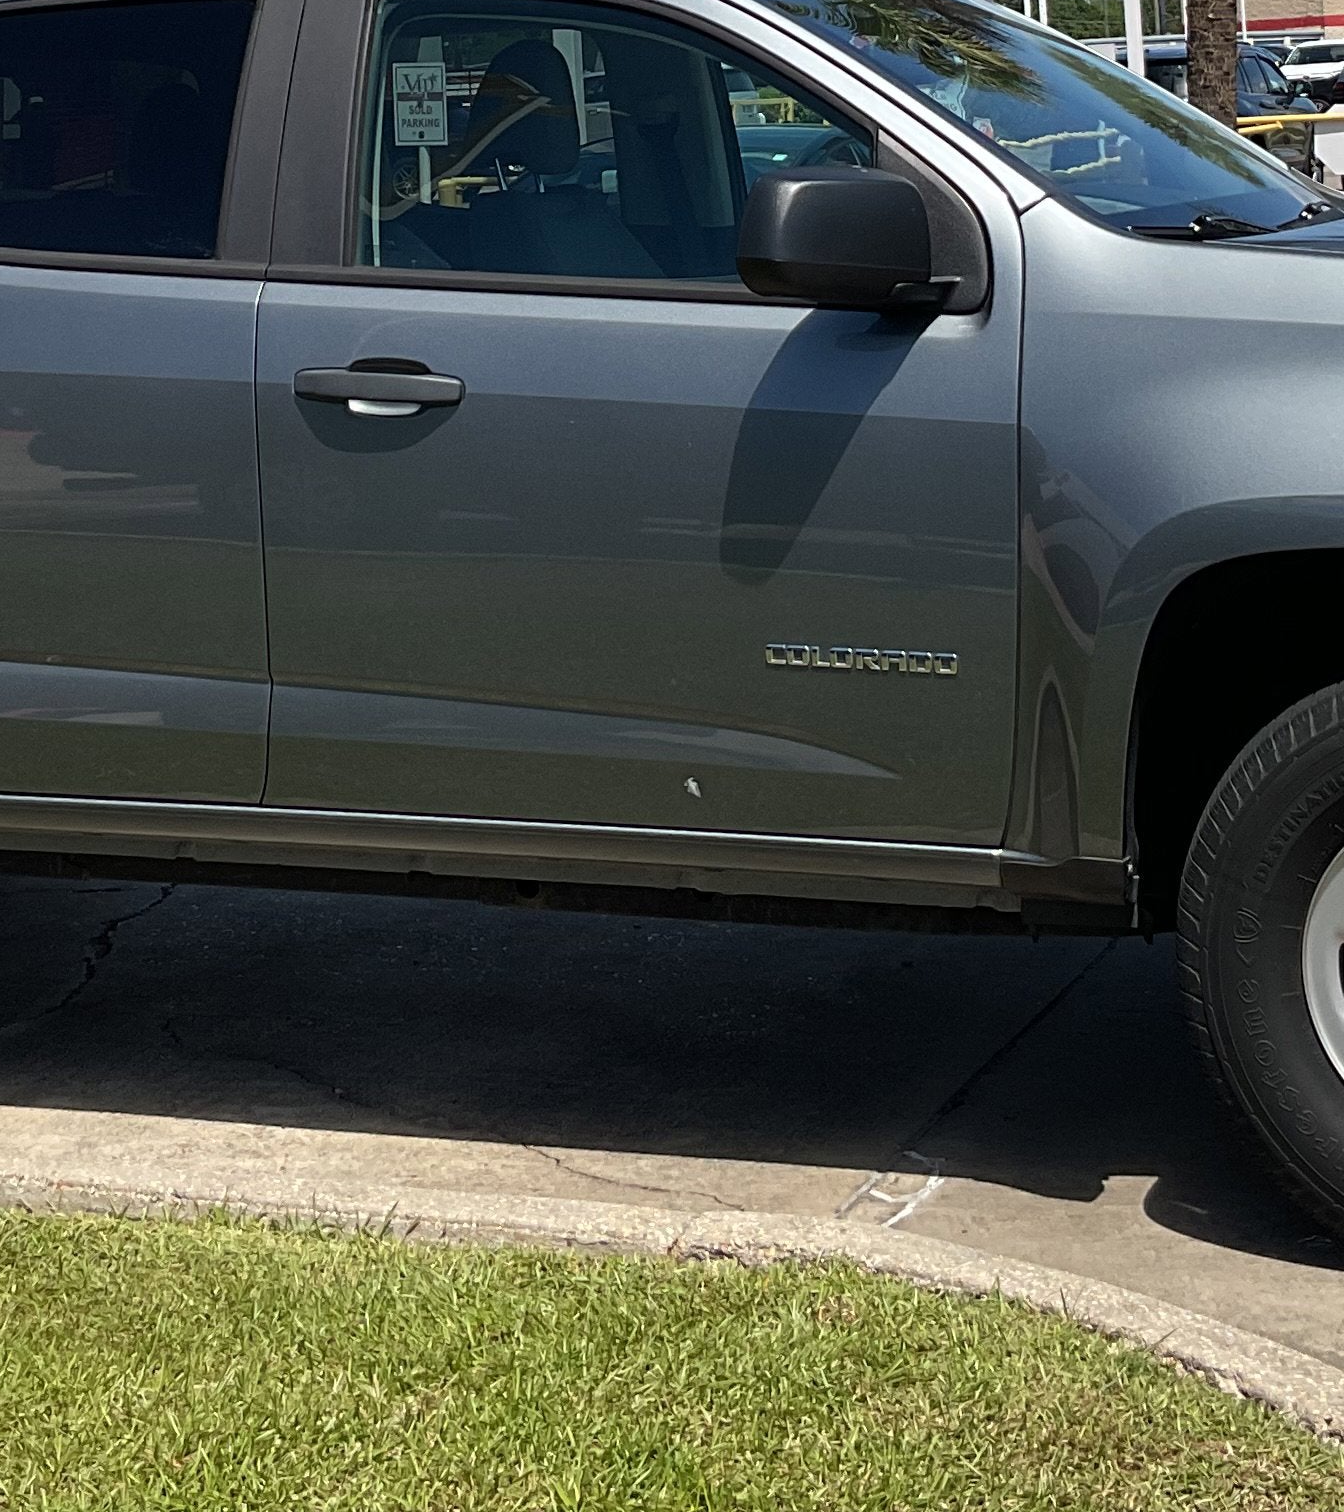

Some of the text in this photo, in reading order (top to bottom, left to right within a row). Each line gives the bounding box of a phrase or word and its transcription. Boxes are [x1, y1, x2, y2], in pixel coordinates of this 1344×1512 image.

[408, 104, 433, 115] SOLD
[401, 118, 440, 128] PARKING
[764, 642, 960, 676] COLORADO
